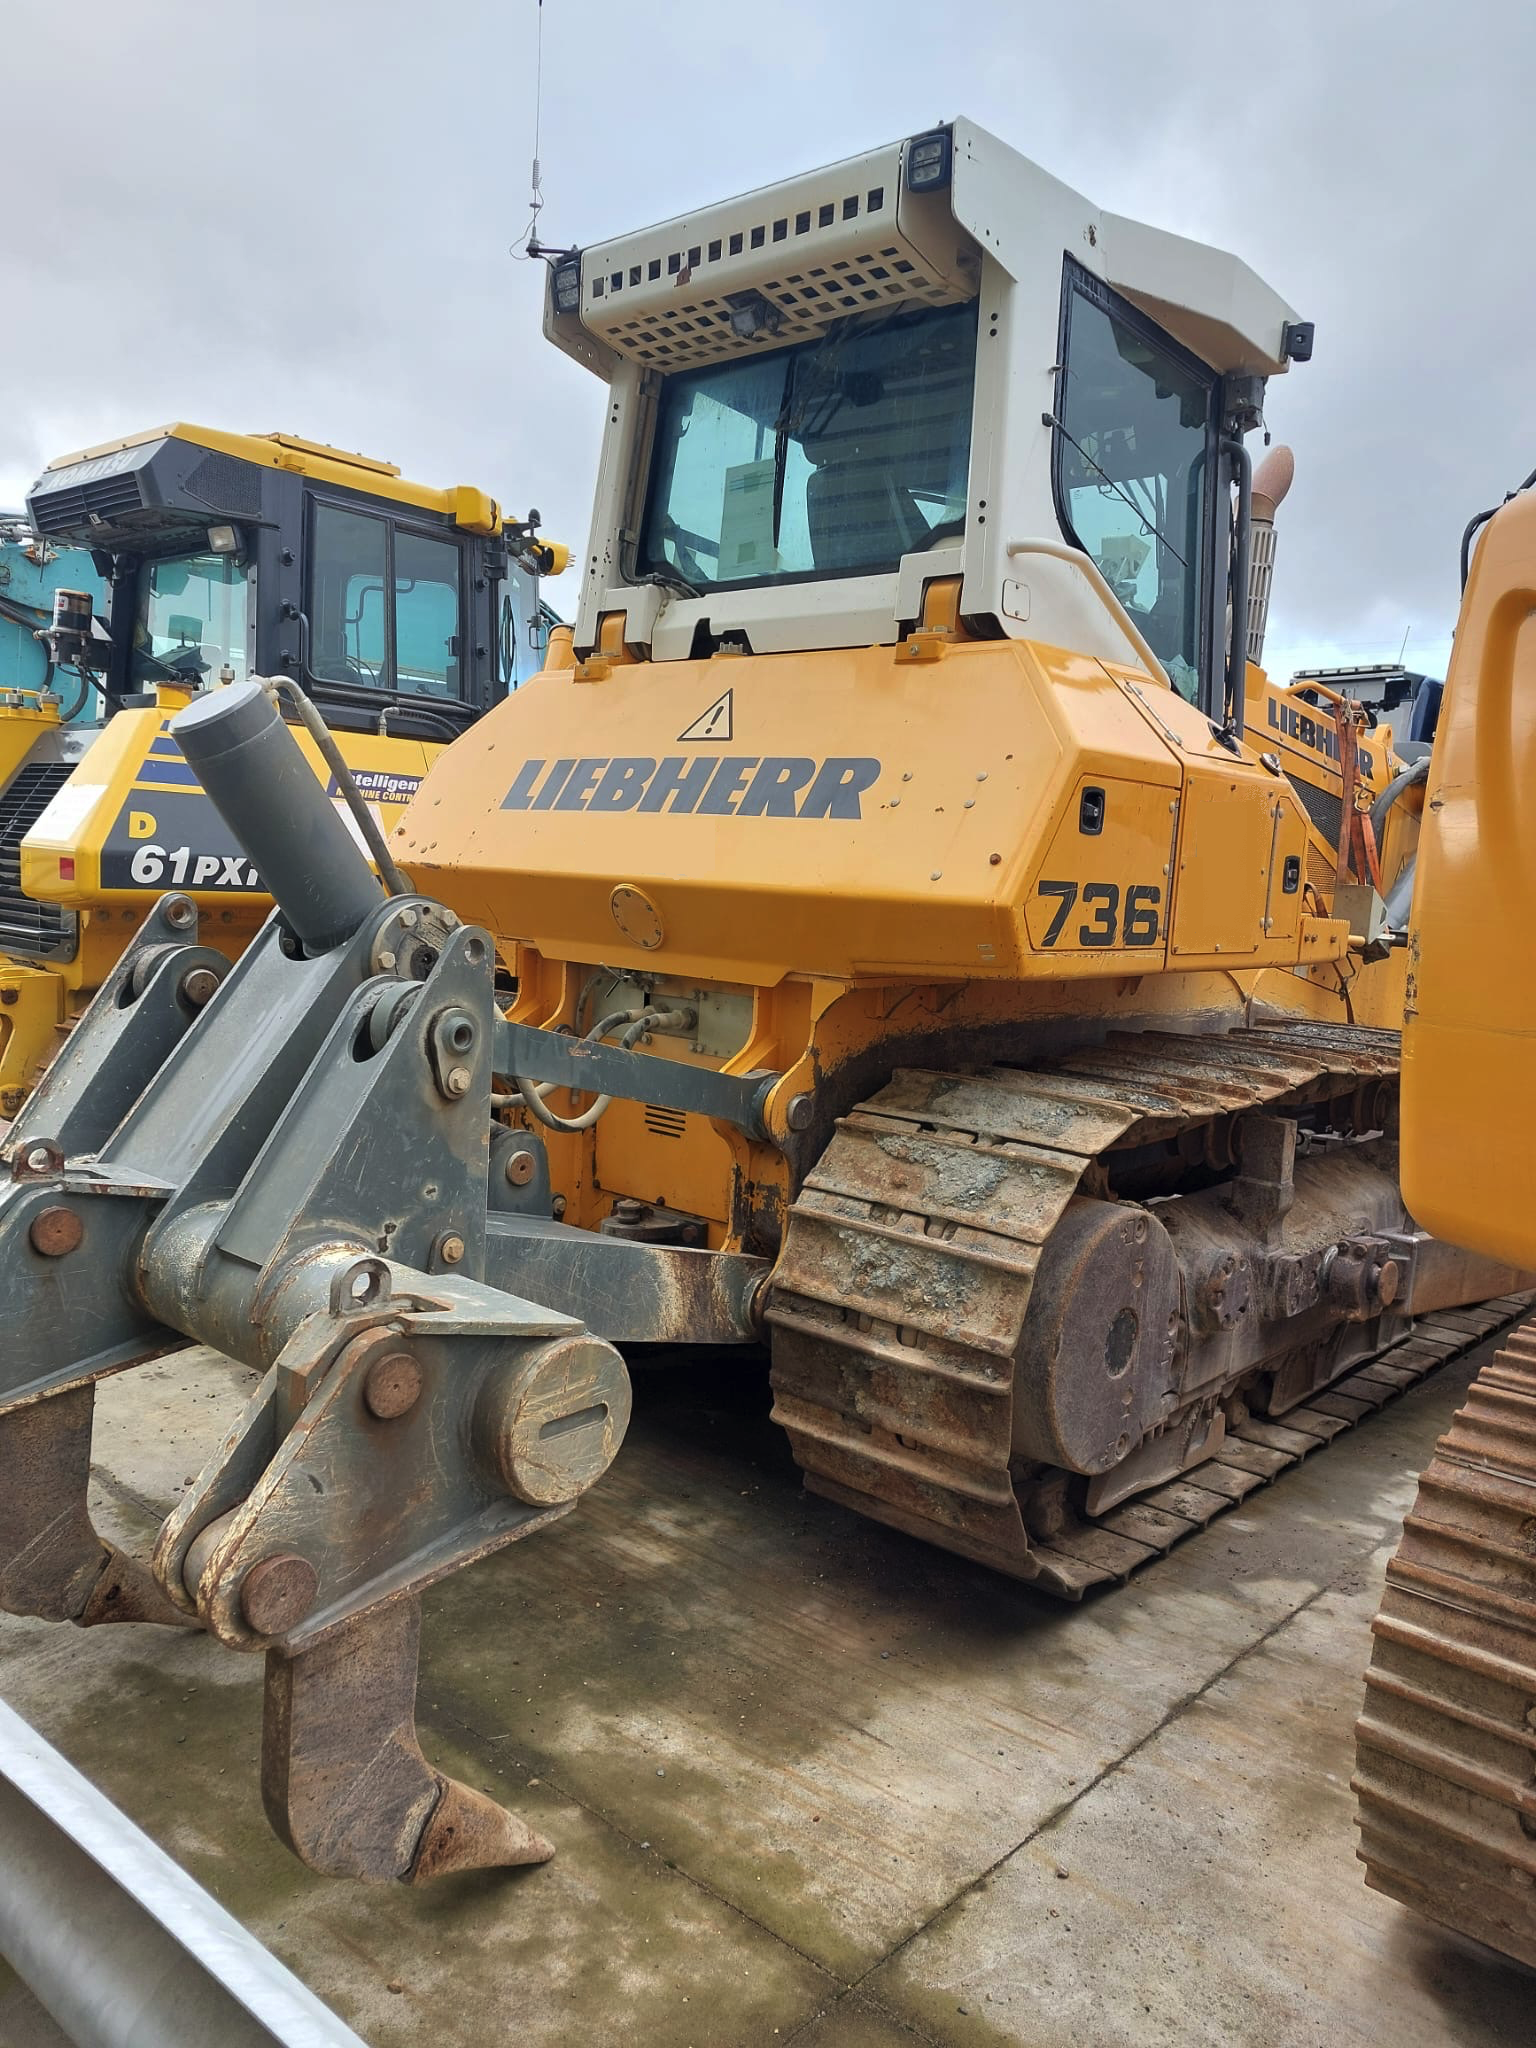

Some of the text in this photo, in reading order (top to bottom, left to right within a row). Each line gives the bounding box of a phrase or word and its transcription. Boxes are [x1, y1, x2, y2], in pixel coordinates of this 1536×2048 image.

[1268, 697, 1374, 780] LIEBHR
[335, 787, 413, 803] MHINE CONTR
[351, 773, 421, 793] telligen
[500, 757, 882, 820] LIEBHERR
[128, 810, 157, 839] D
[1038, 879, 1161, 947] 736
